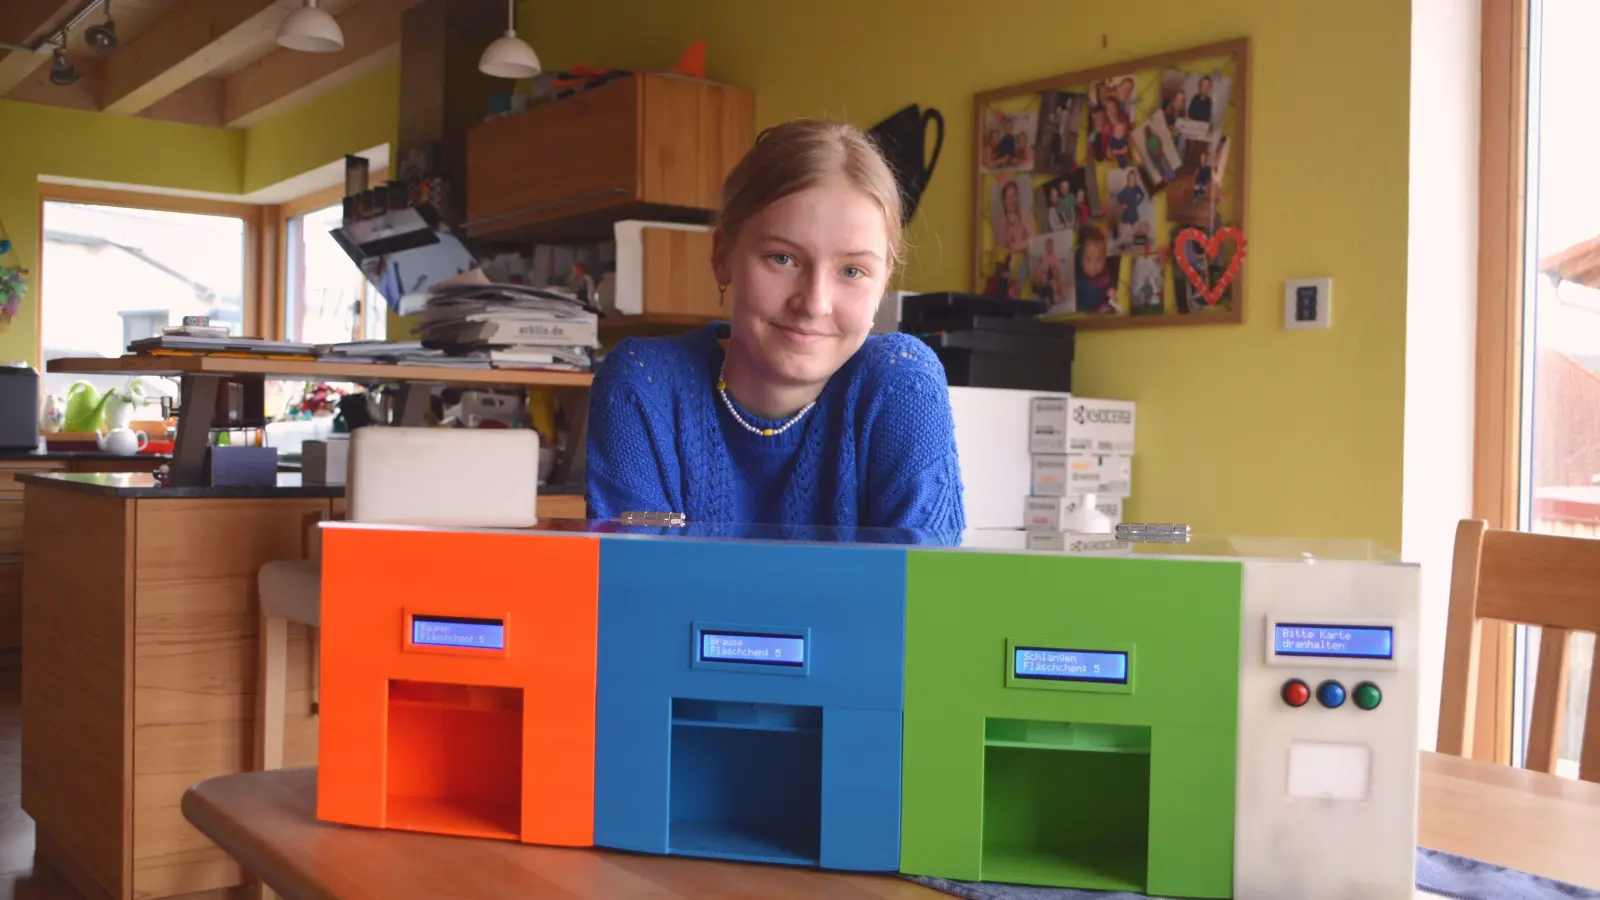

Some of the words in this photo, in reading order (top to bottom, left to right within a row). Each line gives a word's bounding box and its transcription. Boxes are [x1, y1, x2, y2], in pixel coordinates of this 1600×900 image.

[1282, 628, 1314, 638] Bitte
[1319, 630, 1351, 640] Karte
[478, 635, 485, 644] 5
[1282, 639, 1345, 650] dranhalten
[774, 648, 782, 658] 5
[1023, 651, 1077, 663] Schlangen
[1093, 664, 1101, 673] 5
